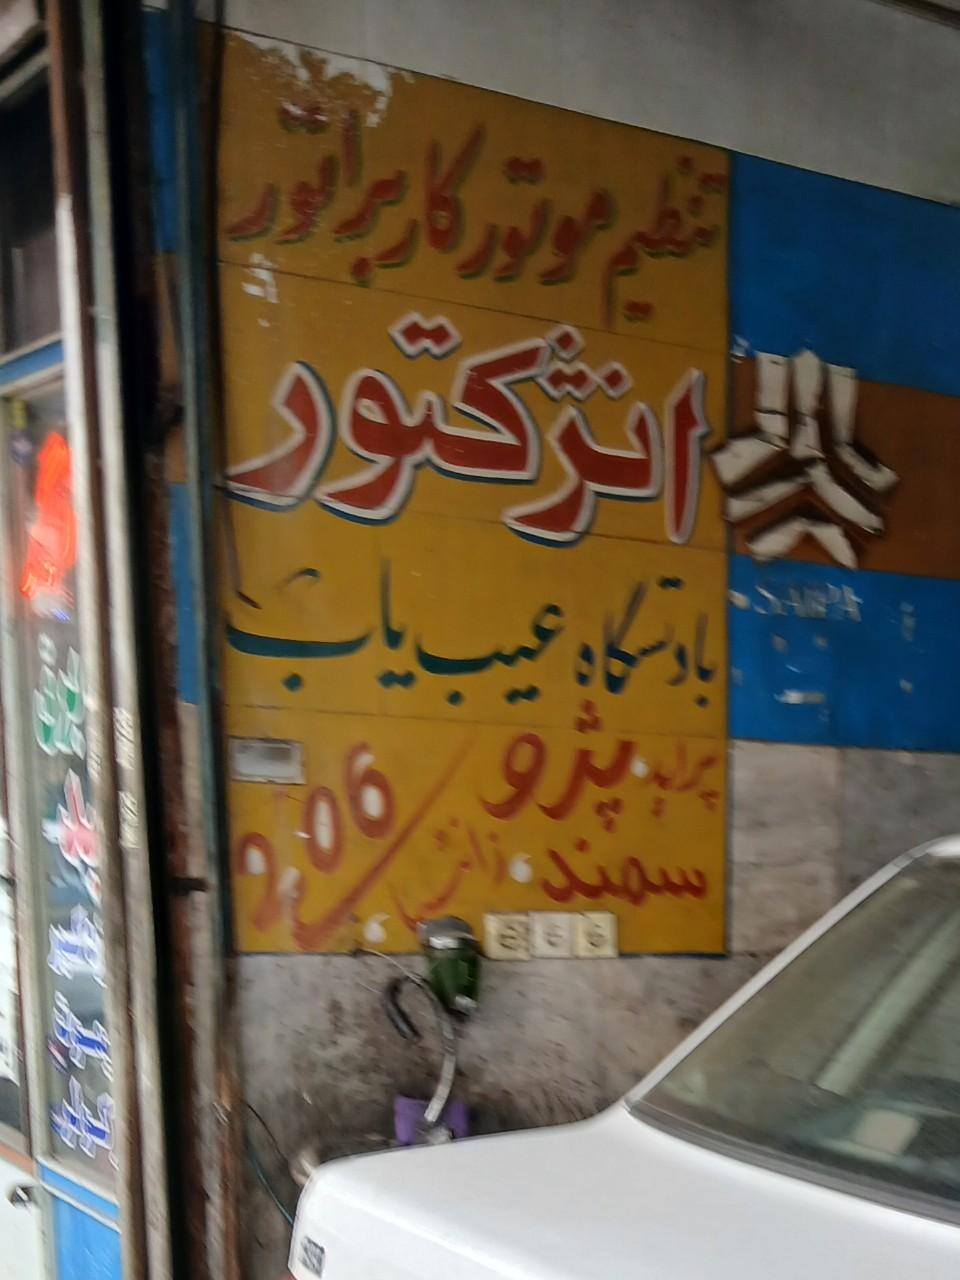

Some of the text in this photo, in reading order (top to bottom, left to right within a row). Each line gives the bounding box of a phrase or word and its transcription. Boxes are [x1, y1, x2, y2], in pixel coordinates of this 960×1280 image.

[226, 100, 729, 329] تنظیم موتور کاربراتور
[224, 310, 710, 549] انژکتور
[226, 557, 418, 693] یاب
[414, 602, 565, 707] عیب
[479, 700, 638, 833] پژو
[541, 838, 709, 906] سمند
